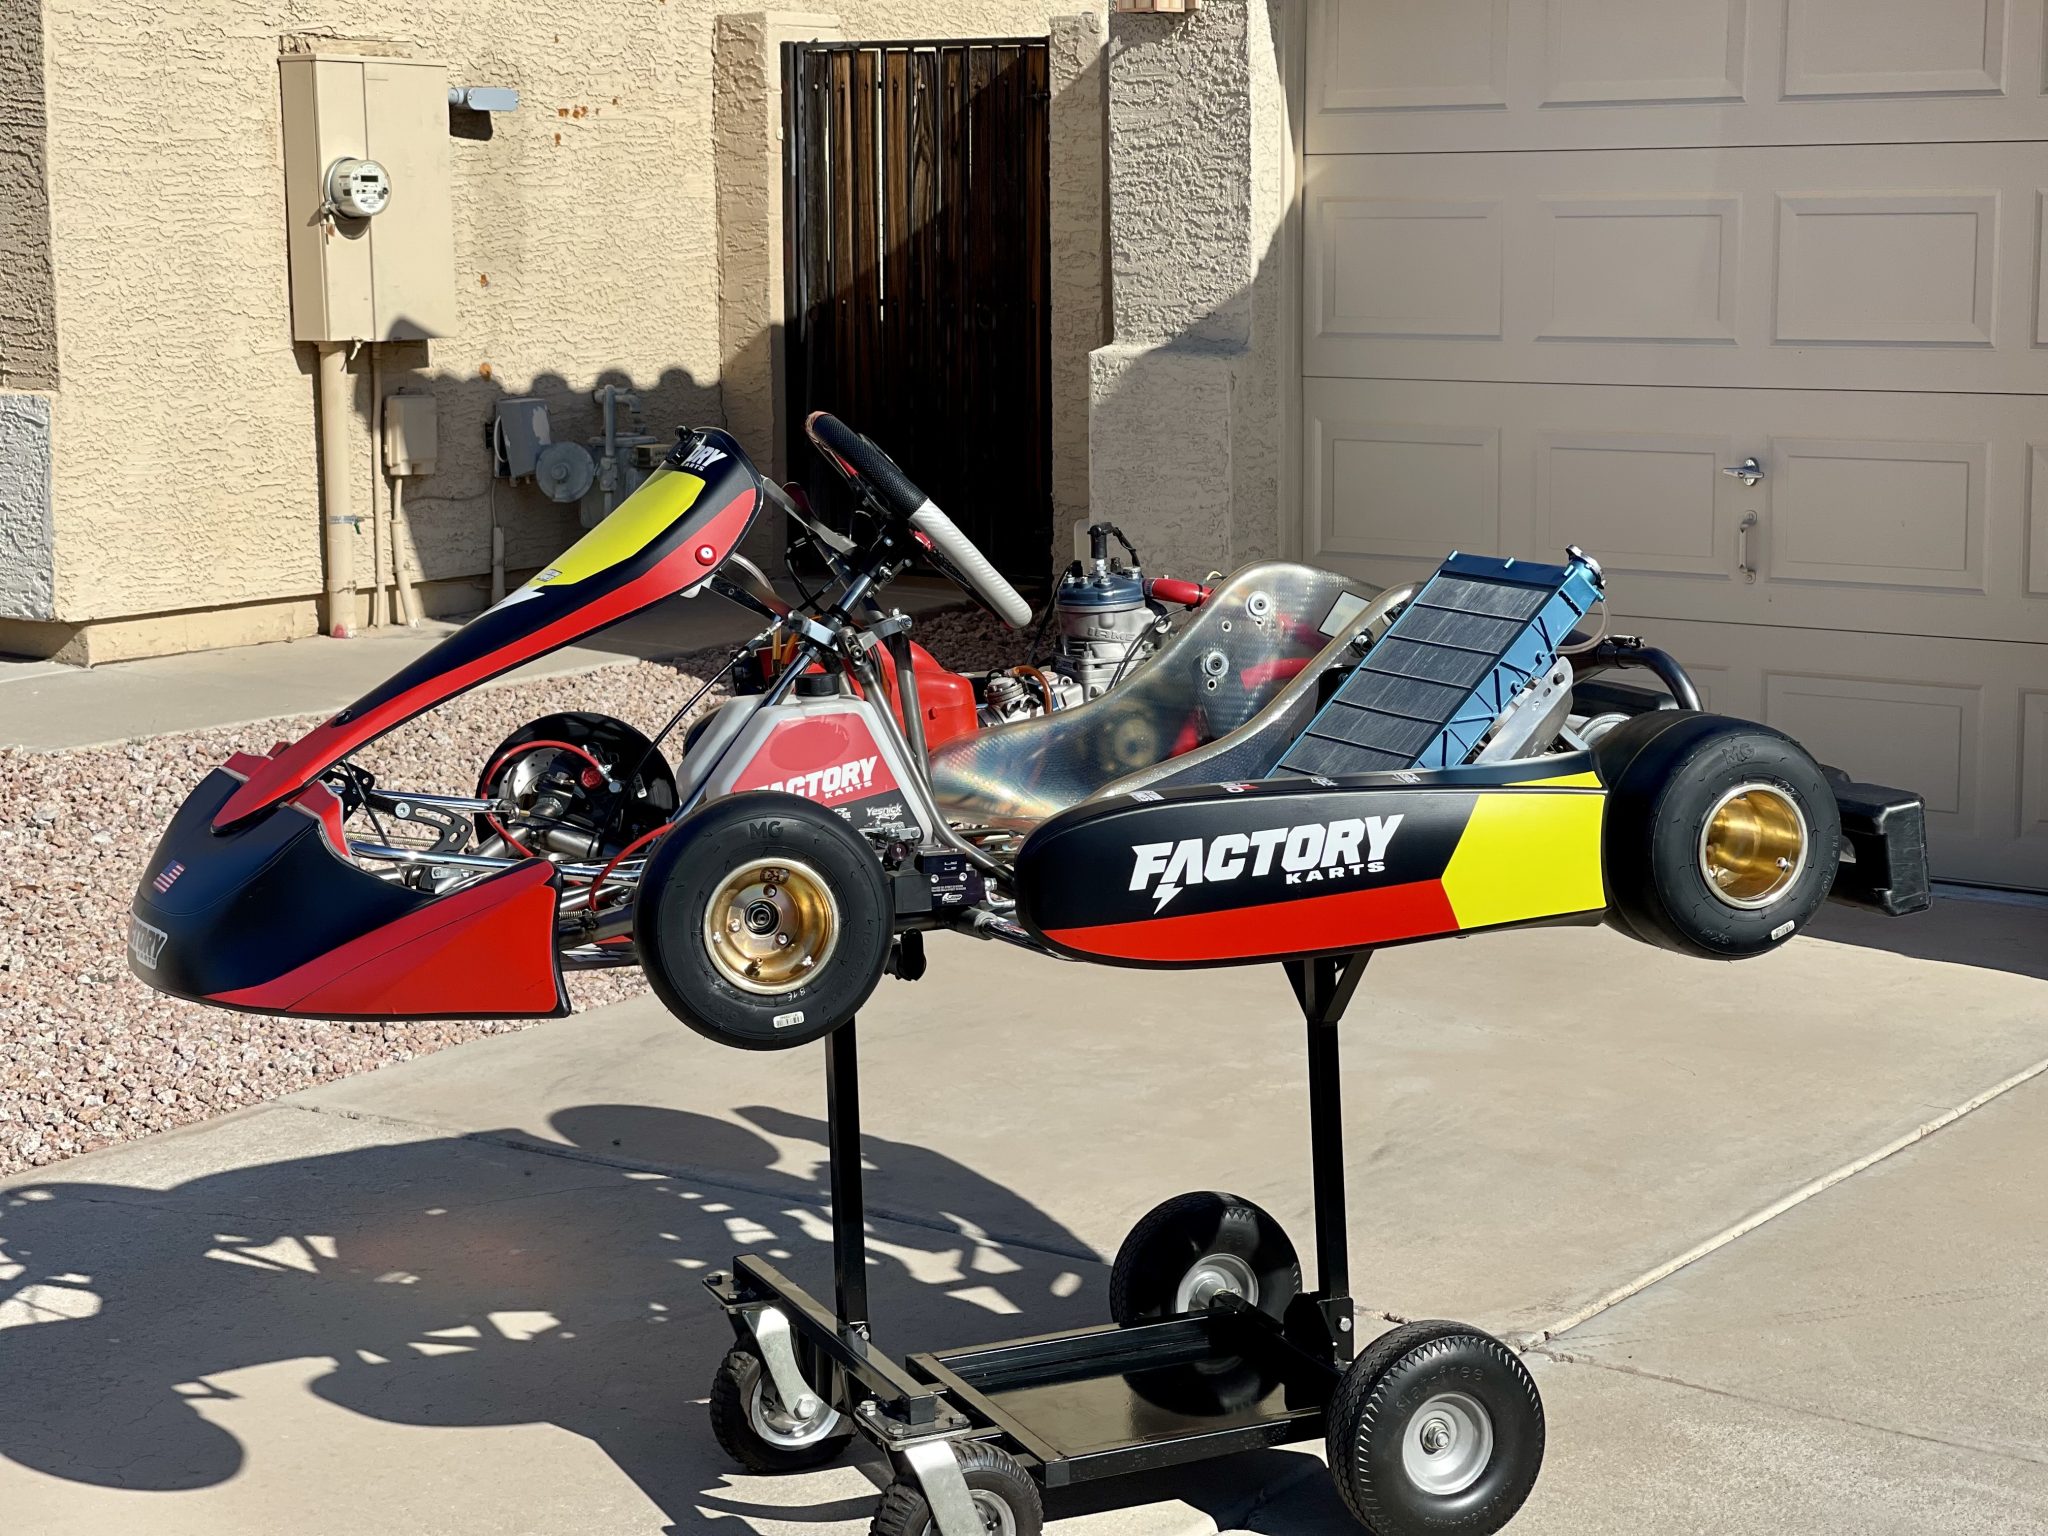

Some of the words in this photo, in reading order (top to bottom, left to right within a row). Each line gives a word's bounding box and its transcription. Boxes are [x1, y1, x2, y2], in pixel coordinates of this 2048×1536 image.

[753, 755, 878, 797] CTORY
[825, 780, 873, 799] KARTS
[749, 821, 784, 839] MG
[1129, 813, 1405, 892] FACTORY
[1286, 861, 1386, 885] KARTS
